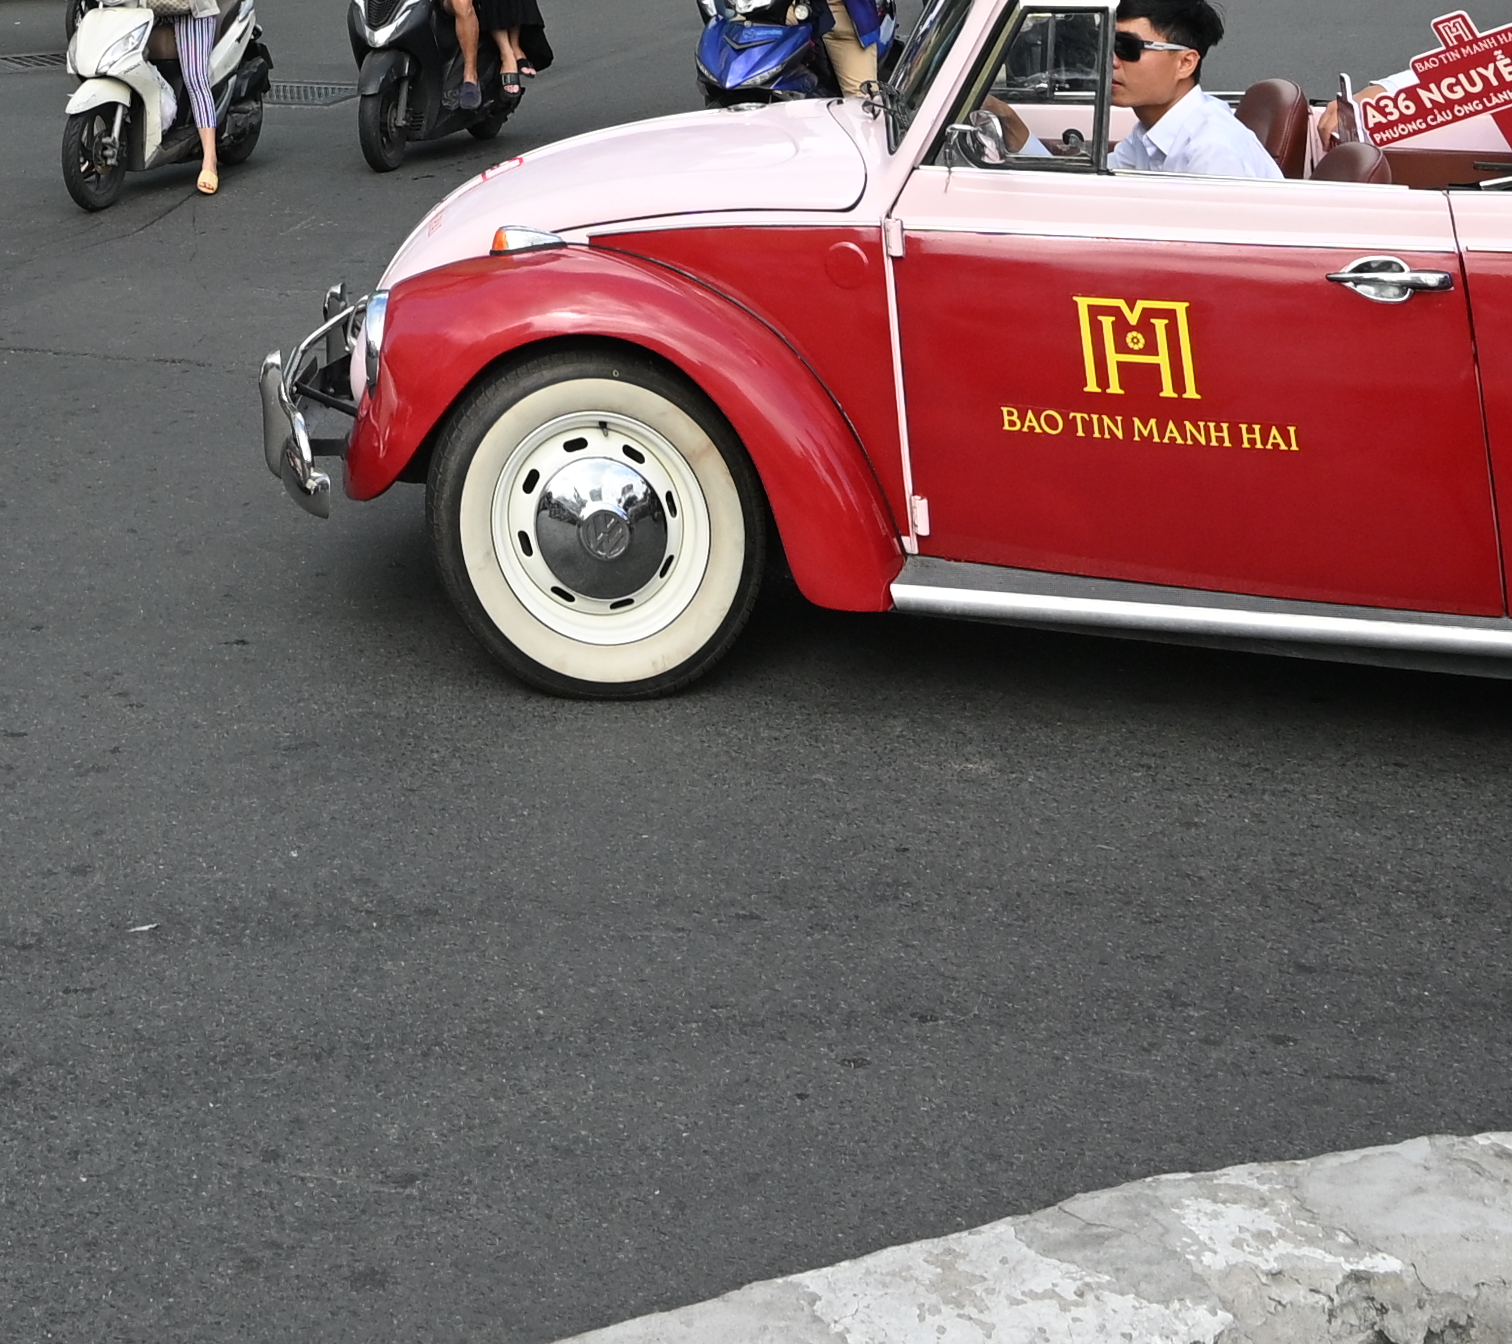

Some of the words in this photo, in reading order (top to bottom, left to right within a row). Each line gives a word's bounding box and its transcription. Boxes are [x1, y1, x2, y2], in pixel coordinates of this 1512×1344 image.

[1414, 59, 1439, 73] BAO
[1437, 48, 1461, 66] TIN
[1461, 36, 1498, 60] MANH
[1365, 96, 1416, 128] A36
[1373, 117, 1426, 145] PHƯỜNG
[1427, 108, 1454, 126] CẦU
[1453, 100, 1484, 122] ÔNG
[1001, 406, 1064, 434] BAO
[1068, 412, 1124, 440] TIN
[1132, 416, 1232, 447] MANH
[1240, 423, 1300, 451] HAI
